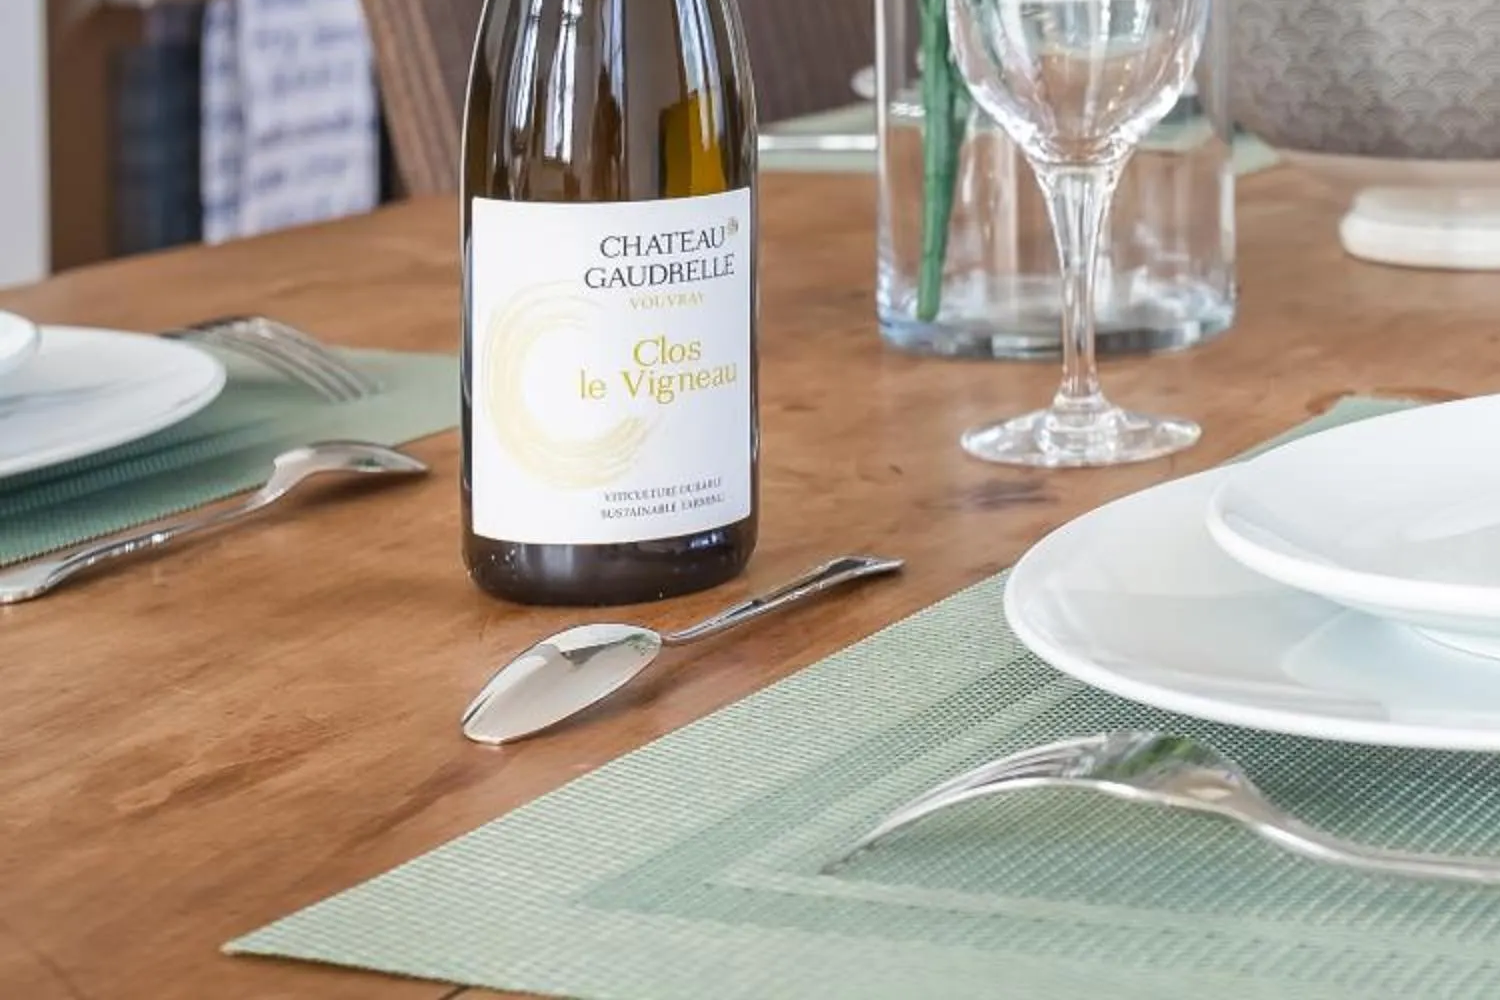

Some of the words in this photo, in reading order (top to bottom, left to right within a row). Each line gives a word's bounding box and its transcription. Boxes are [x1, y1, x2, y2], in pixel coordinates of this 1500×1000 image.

[599, 225, 726, 259] CHATEAU
[584, 253, 735, 289] GAUDRELLE
[629, 291, 705, 310] VOUVRAY
[633, 334, 702, 367] Clos
[580, 367, 607, 400] le
[620, 362, 737, 405] Vigneau
[600, 502, 676, 519] SUSTAINABLE
